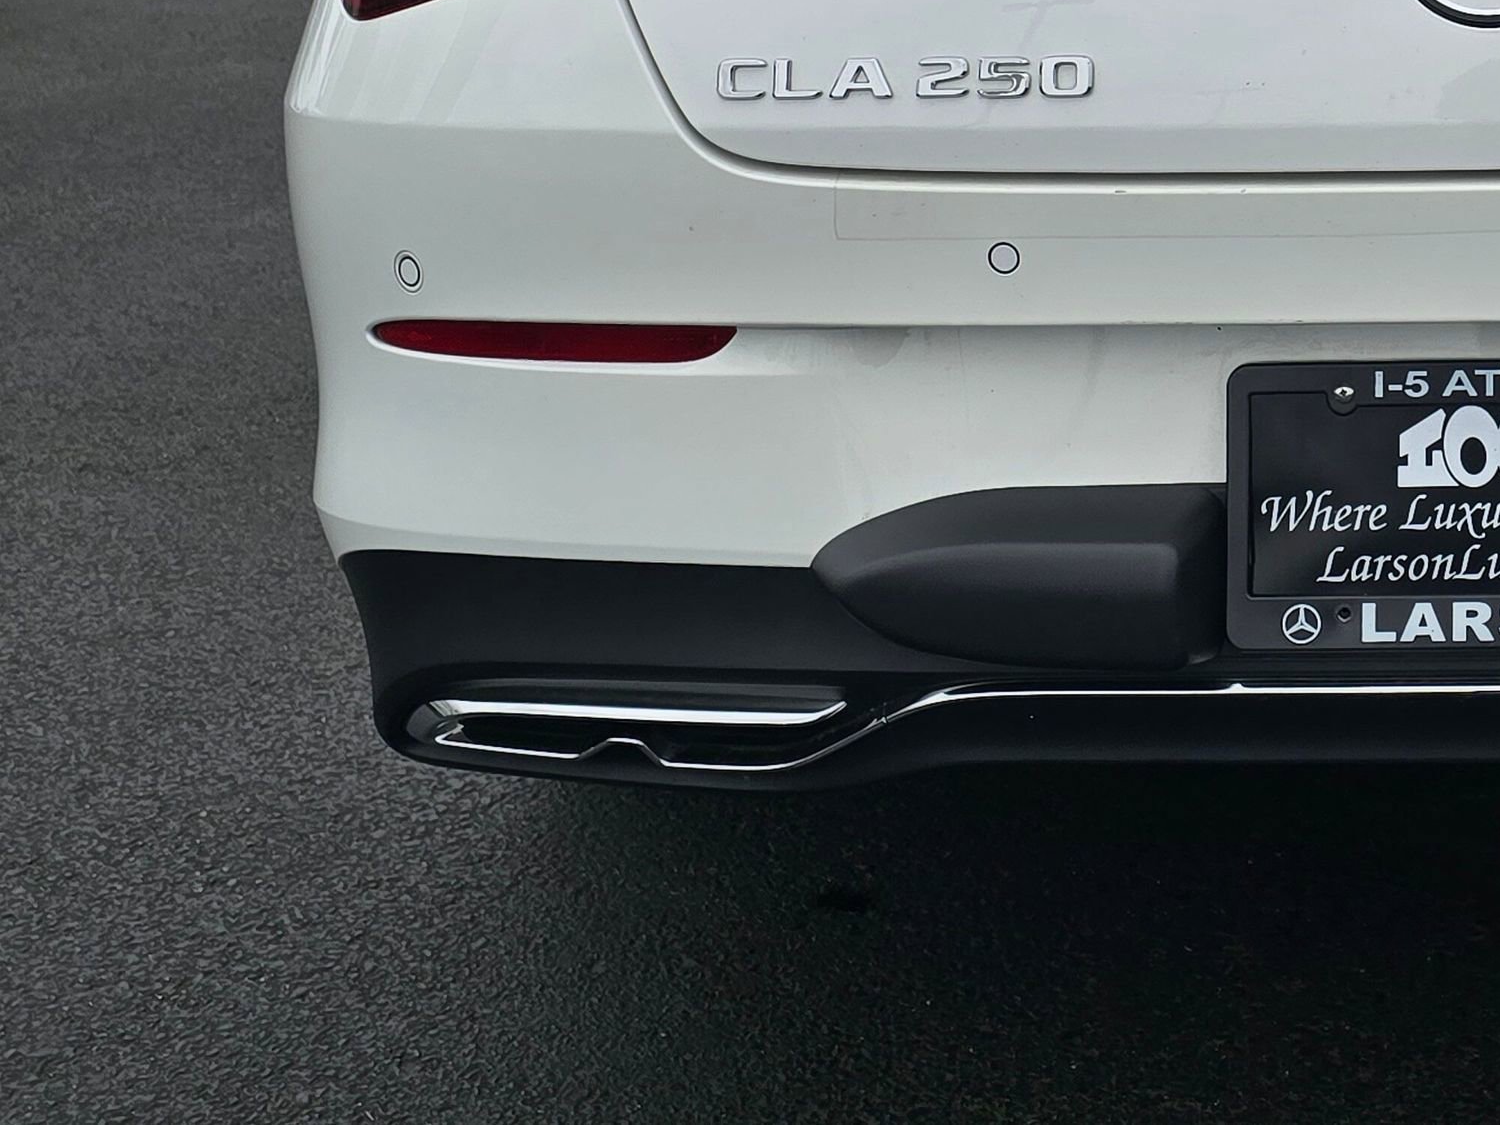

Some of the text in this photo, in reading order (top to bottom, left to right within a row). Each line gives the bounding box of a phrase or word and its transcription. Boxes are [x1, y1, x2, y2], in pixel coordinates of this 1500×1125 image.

[716, 55, 1096, 100] CLA 250
[1374, 370, 1430, 398] I-5
[1260, 490, 1388, 532] Where
